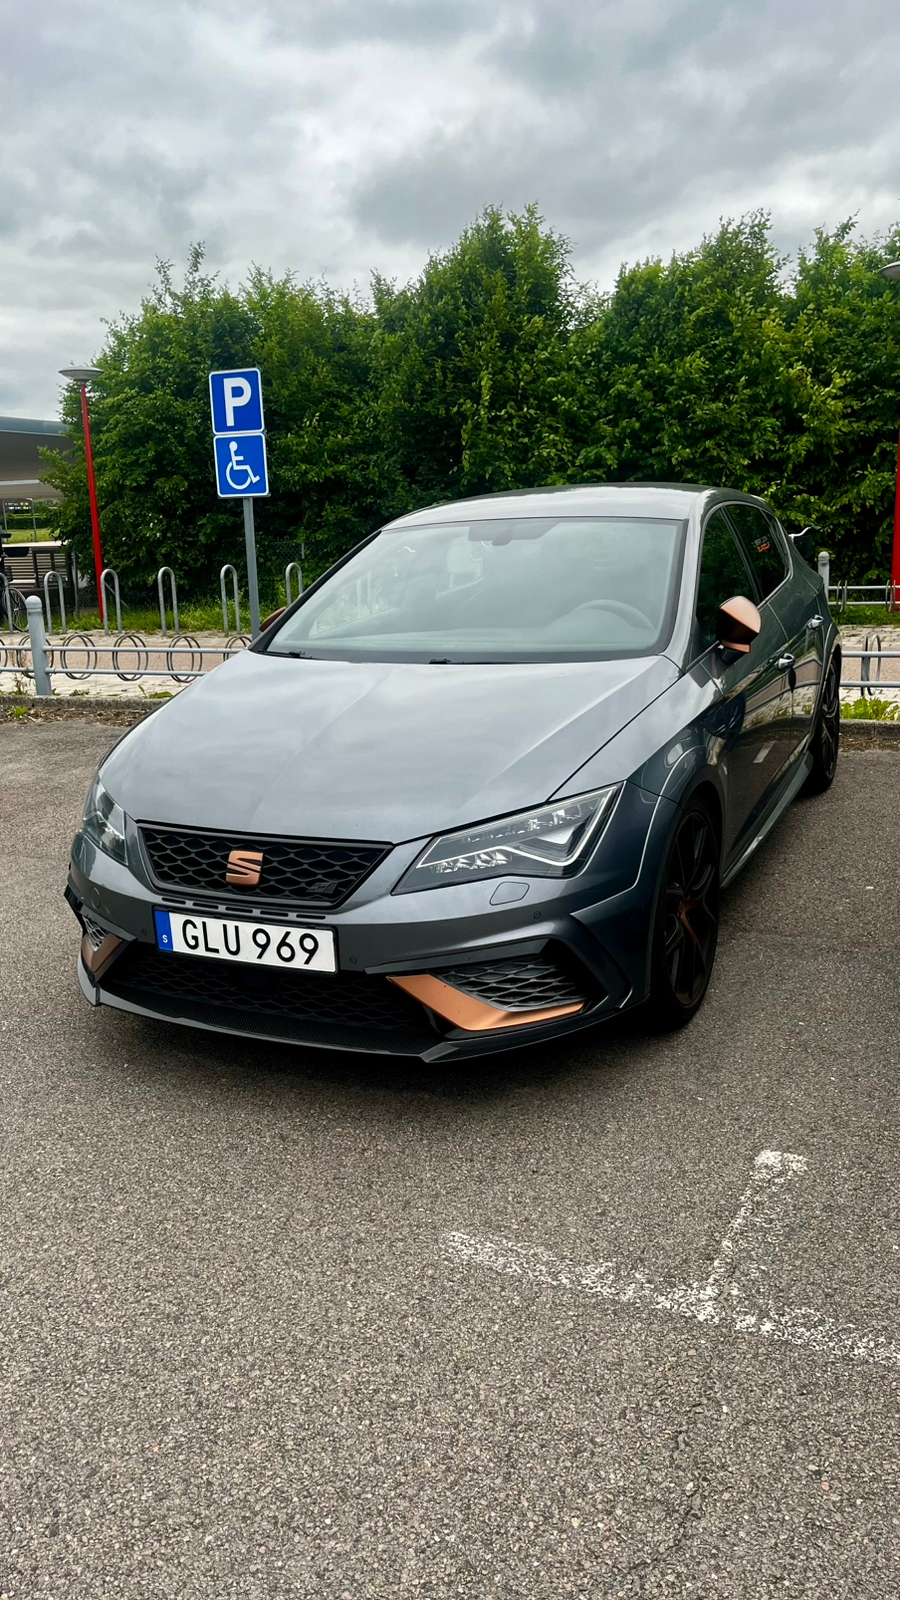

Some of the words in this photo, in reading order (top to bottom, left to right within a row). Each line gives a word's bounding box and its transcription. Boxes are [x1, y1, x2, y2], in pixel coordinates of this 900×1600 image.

[223, 377, 252, 427] P
[162, 934, 168, 944] S
[182, 919, 241, 956] GLU
[252, 928, 319, 965] 969
